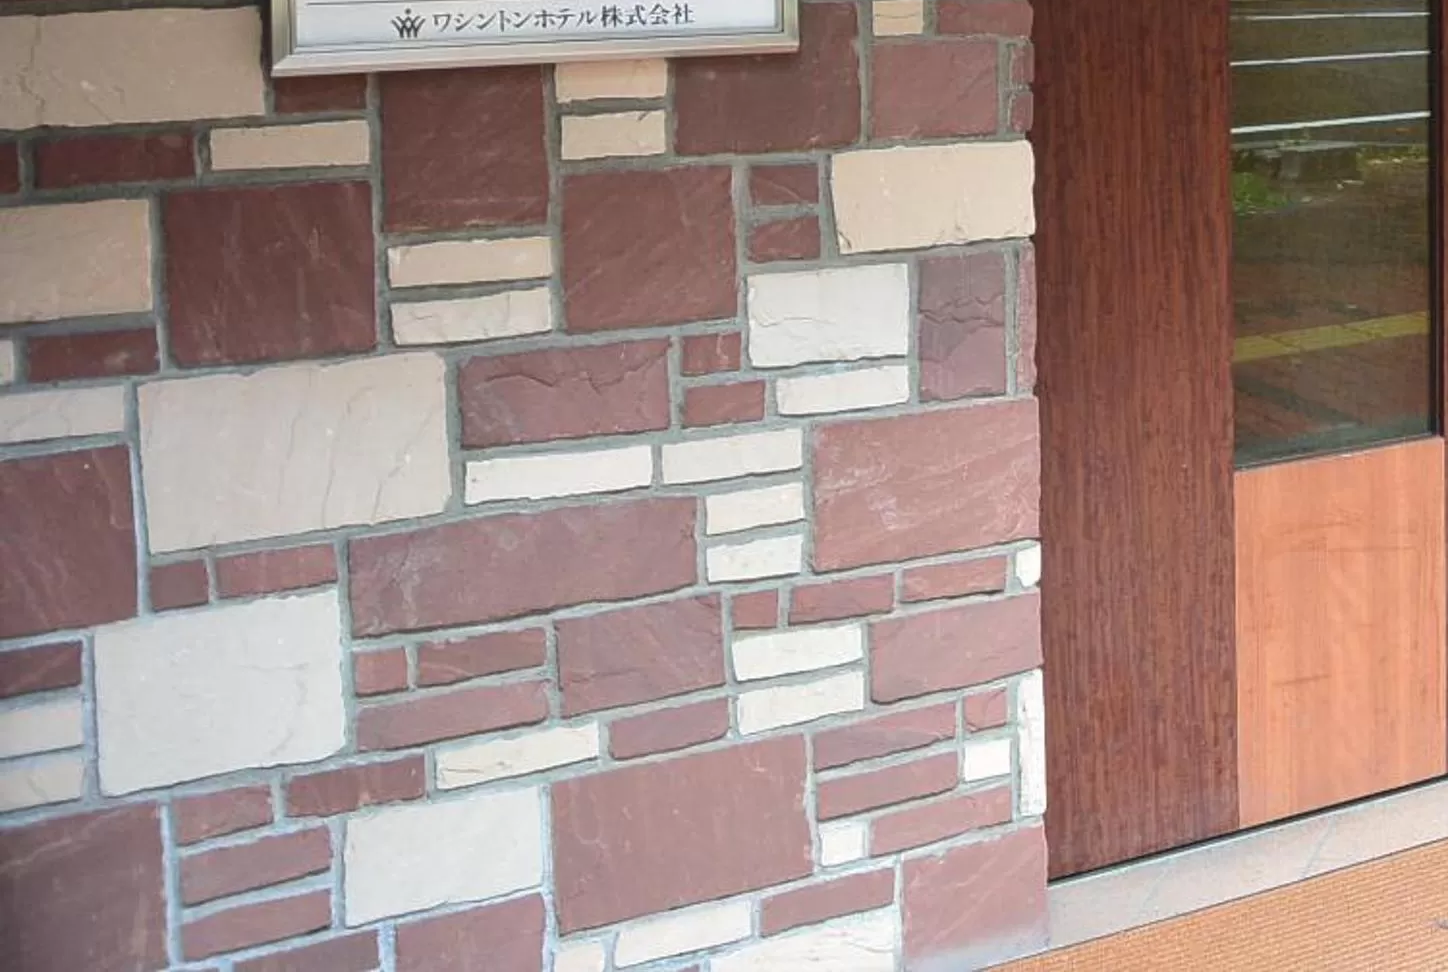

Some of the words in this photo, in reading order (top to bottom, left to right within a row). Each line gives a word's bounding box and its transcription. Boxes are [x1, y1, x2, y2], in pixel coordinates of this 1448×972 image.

[432, 2, 695, 32] ワシントンホテル株式会社
